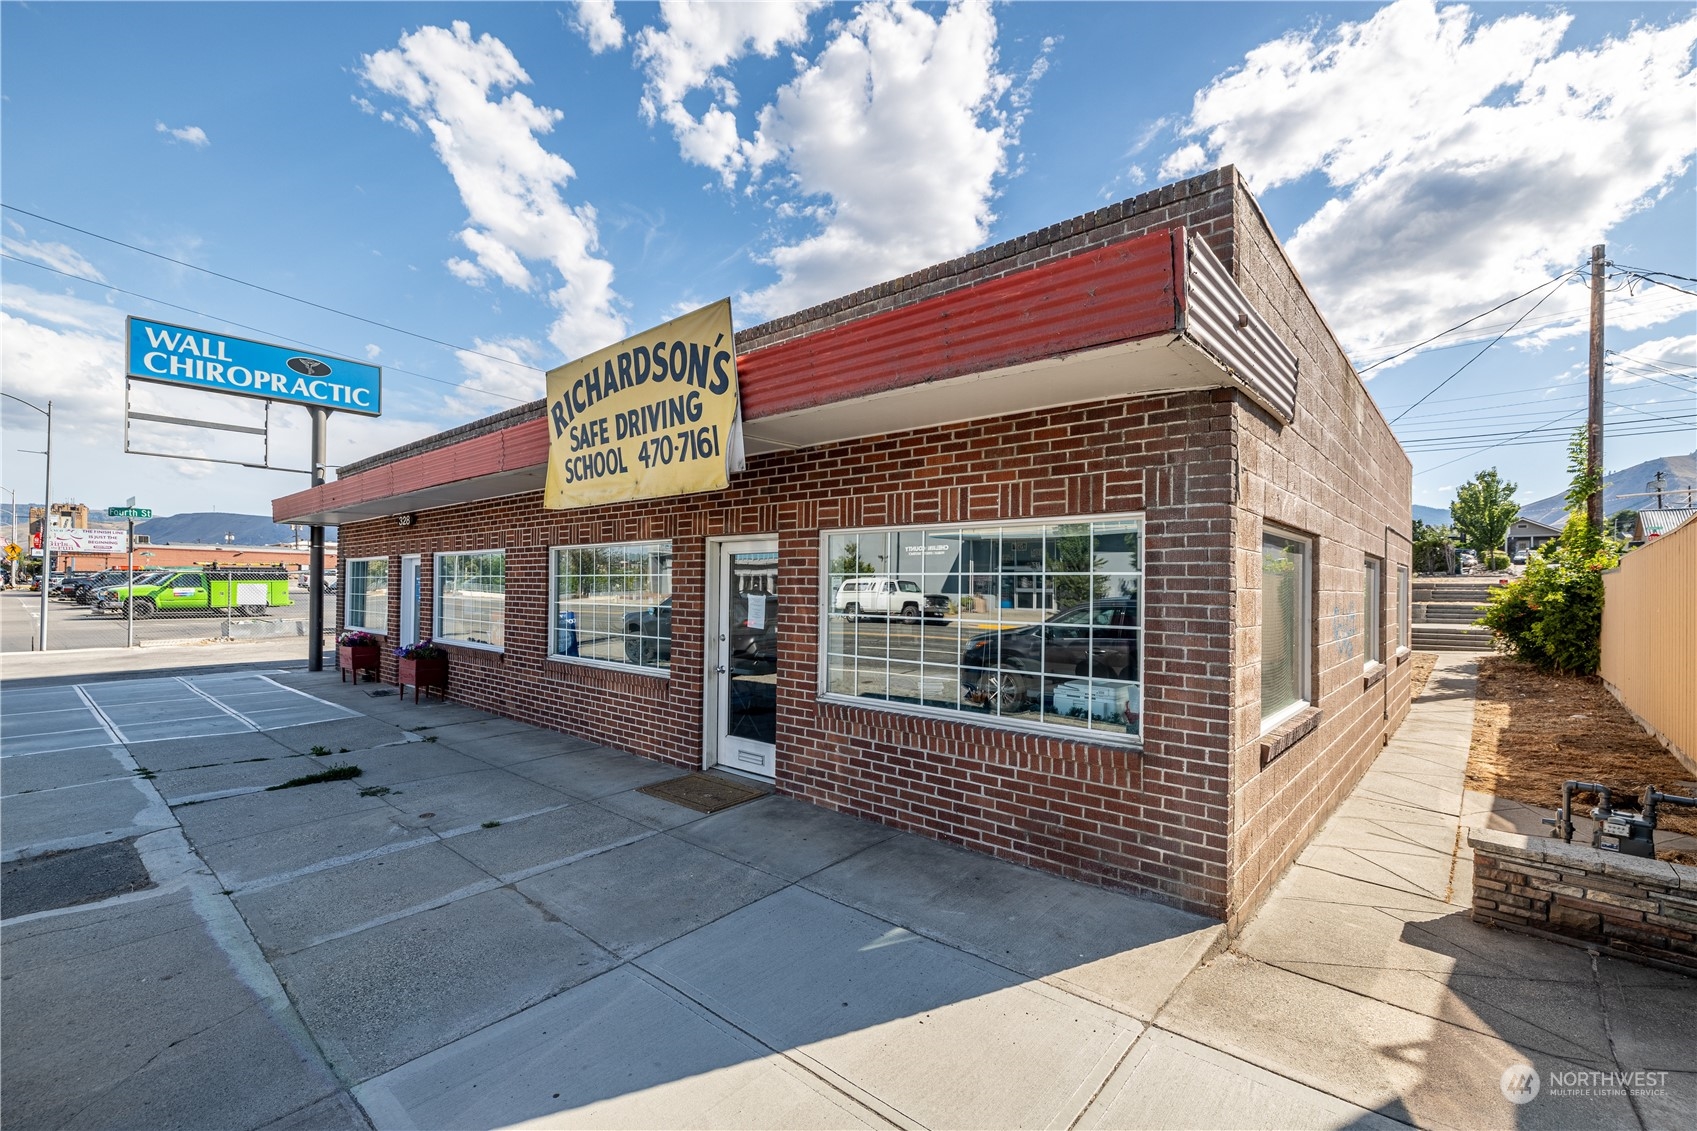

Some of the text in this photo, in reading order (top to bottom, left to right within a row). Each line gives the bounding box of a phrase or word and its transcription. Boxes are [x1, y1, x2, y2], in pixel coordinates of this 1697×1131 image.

[145, 326, 233, 363] WALL
[144, 351, 370, 408] CHIROPRACTIC
[550, 333, 731, 439] RICHARDSON'S
[570, 390, 703, 453] SAFE DRIVING
[565, 447, 628, 484] SCHOOL
[109, 509, 151, 518] Fourth St
[399, 515, 411, 526] 328
